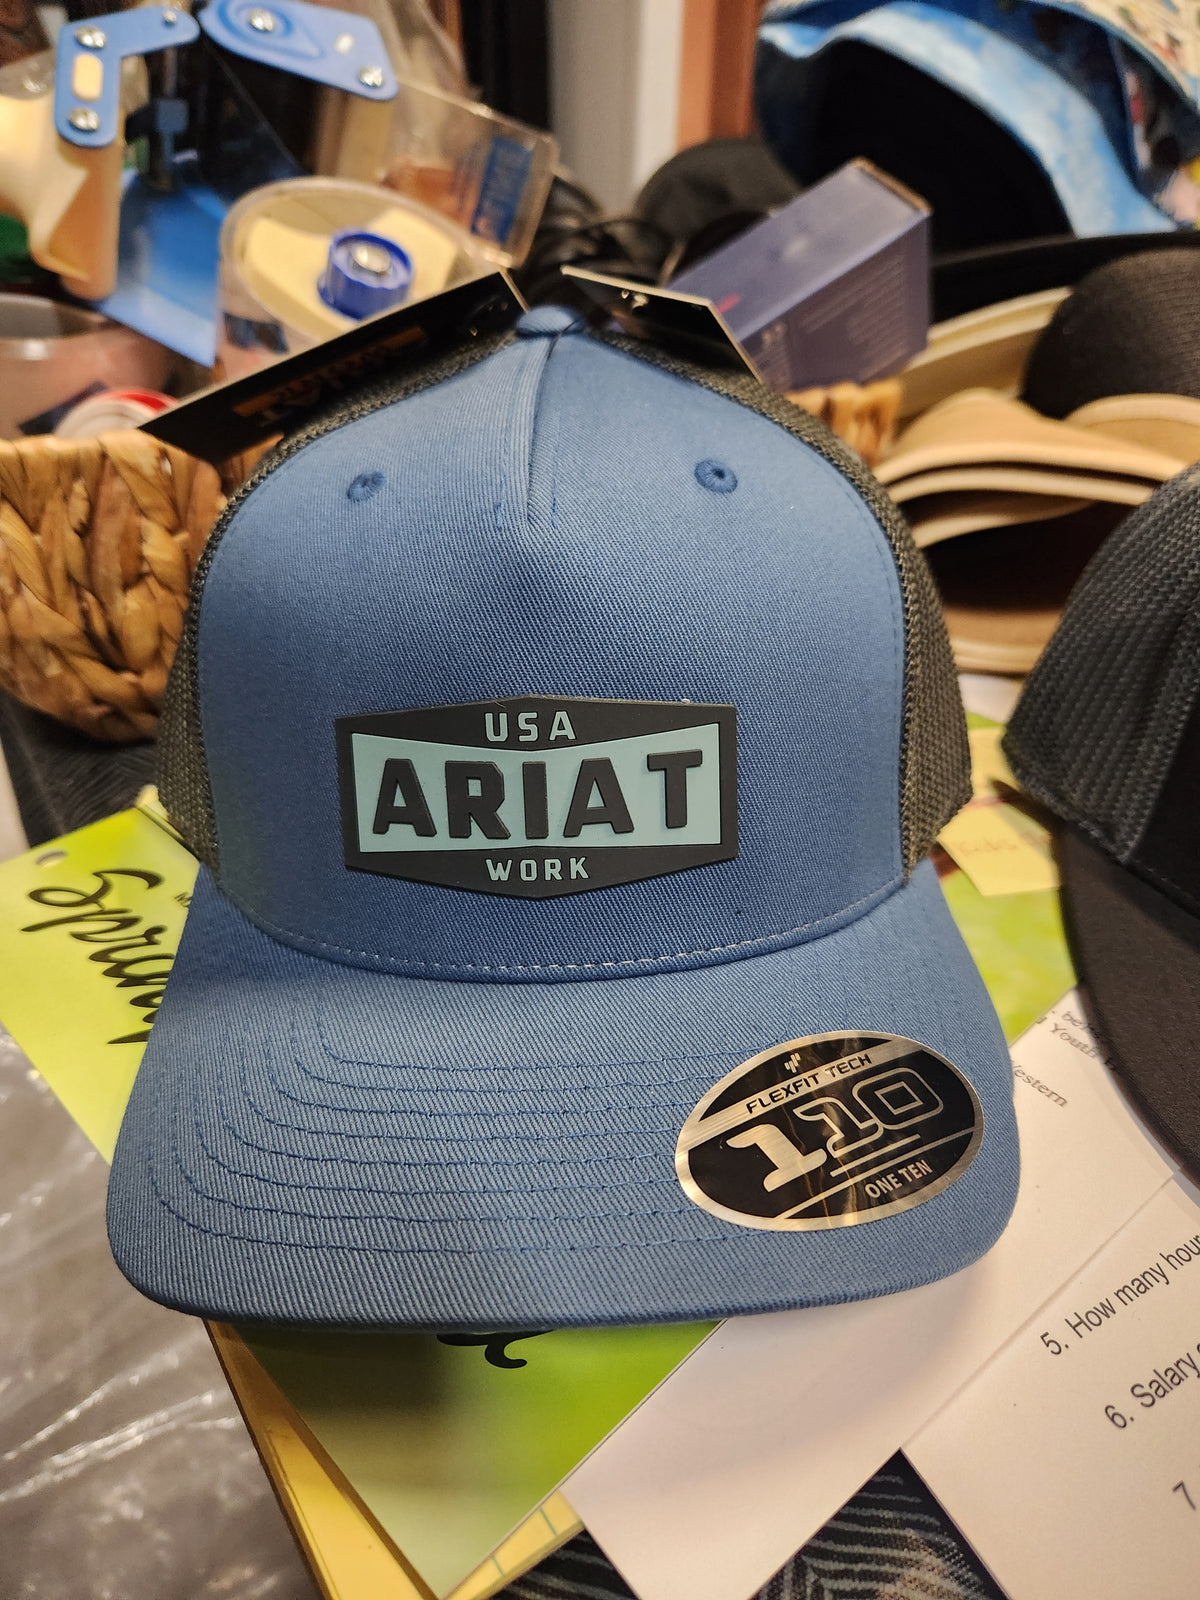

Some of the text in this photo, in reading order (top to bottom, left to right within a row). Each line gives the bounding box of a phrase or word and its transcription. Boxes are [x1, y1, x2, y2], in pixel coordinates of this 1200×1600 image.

[485, 710, 577, 742] USA
[372, 749, 703, 839] ARIAT
[486, 857, 588, 881] WORK
[746, 1053, 873, 1114] FLEXFIT TECH
[726, 1067, 944, 1193] 110
[864, 1159, 933, 1199] ONE TEN
[1040, 1332, 1069, 1356] 5.
[1064, 1297, 1117, 1338] How
[1113, 1262, 1170, 1306] many
[1104, 1352, 1200, 1430] 6. Salary
